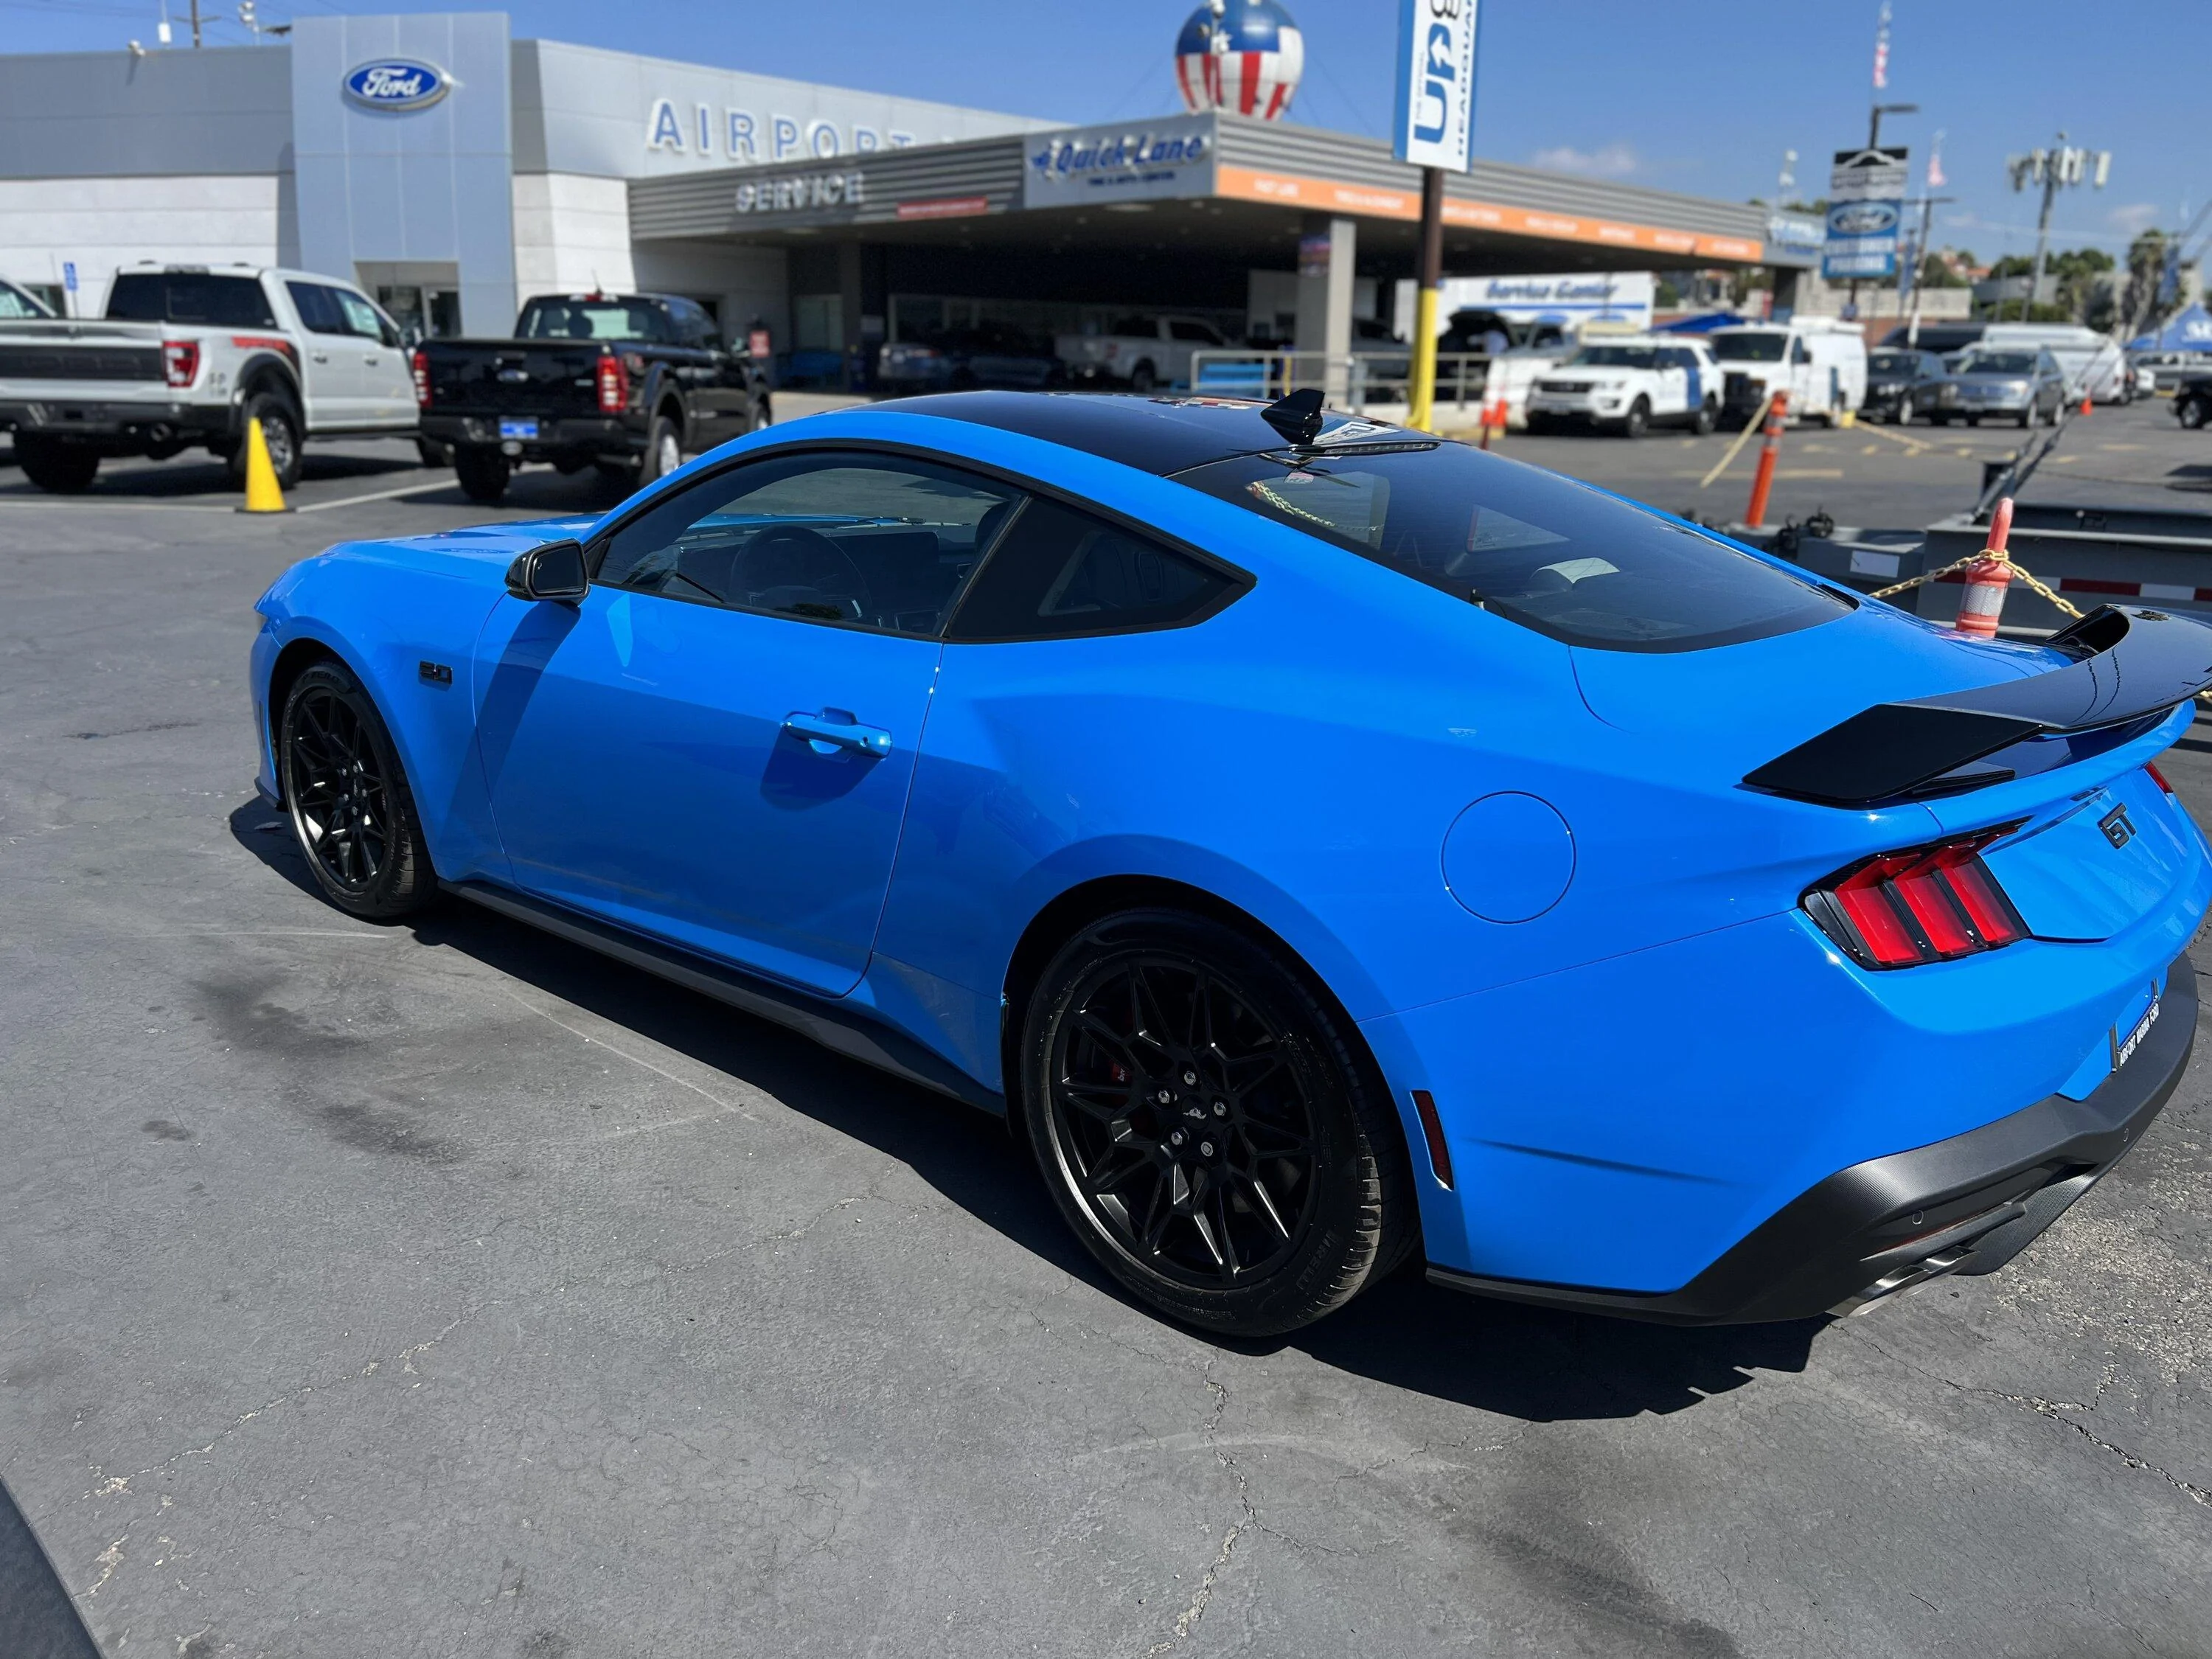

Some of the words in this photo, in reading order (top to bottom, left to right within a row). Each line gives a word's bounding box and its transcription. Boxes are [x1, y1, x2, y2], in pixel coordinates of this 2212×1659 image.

[362, 67, 422, 97] Ford
[1055, 136, 1125, 175] Quick
[1133, 133, 1203, 165] Lane
[736, 171, 864, 215] SERVICE
[2097, 801, 2137, 850] GT
[2149, 1003, 2159, 1025] FORD
